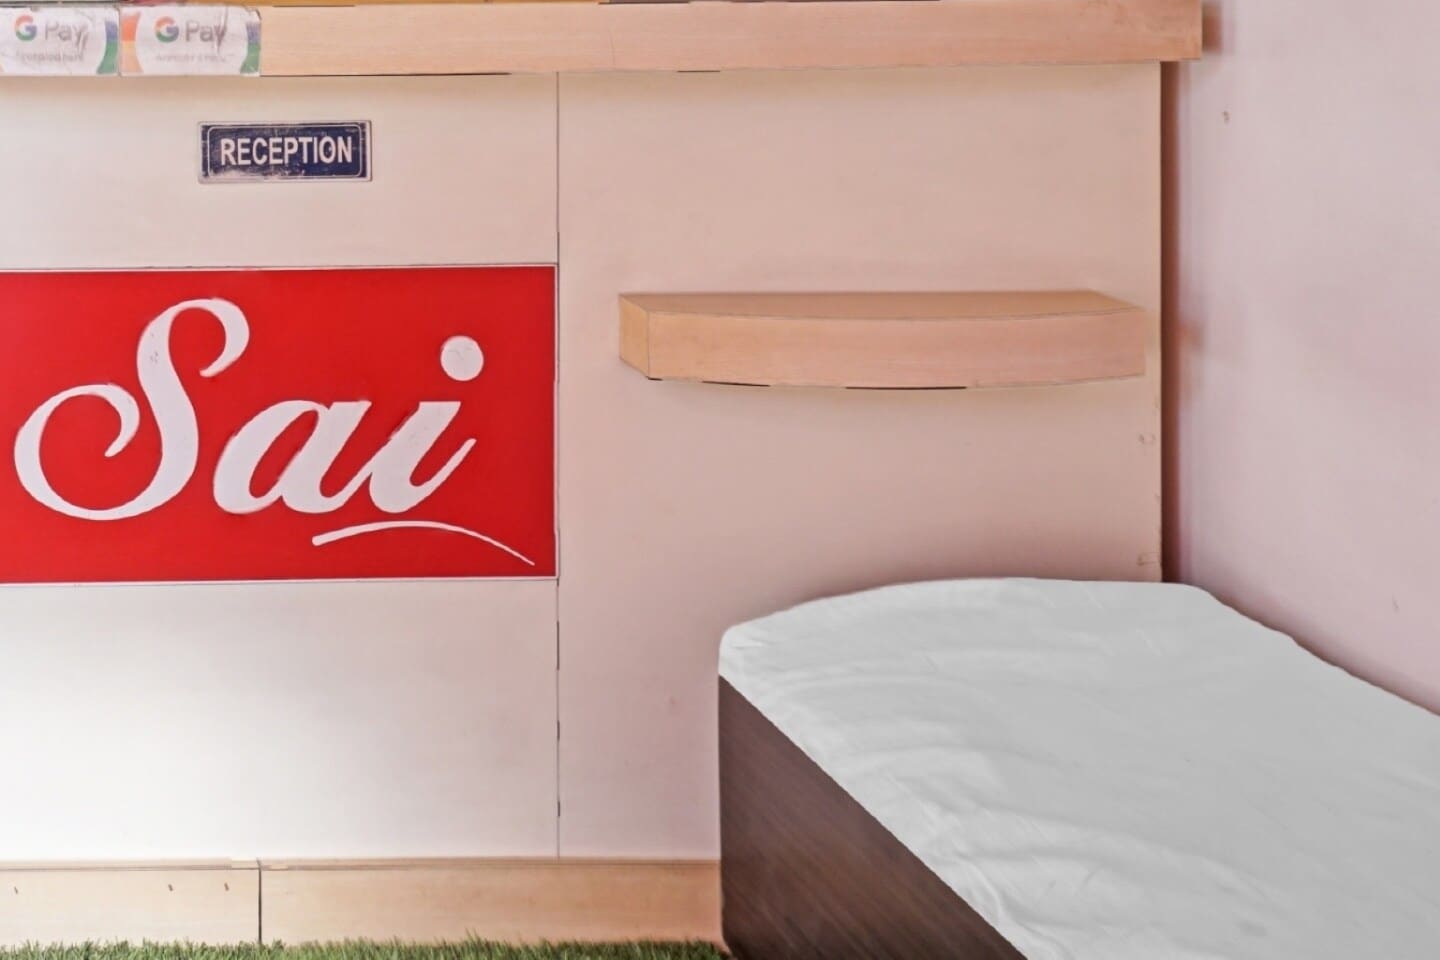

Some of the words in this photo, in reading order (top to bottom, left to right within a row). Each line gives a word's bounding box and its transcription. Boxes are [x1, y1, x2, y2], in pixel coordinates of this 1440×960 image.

[45, 20, 88, 49] Pay
[185, 20, 227, 49] Pay
[220, 136, 353, 166] RECEPTION
[14, 297, 484, 521] Sai
